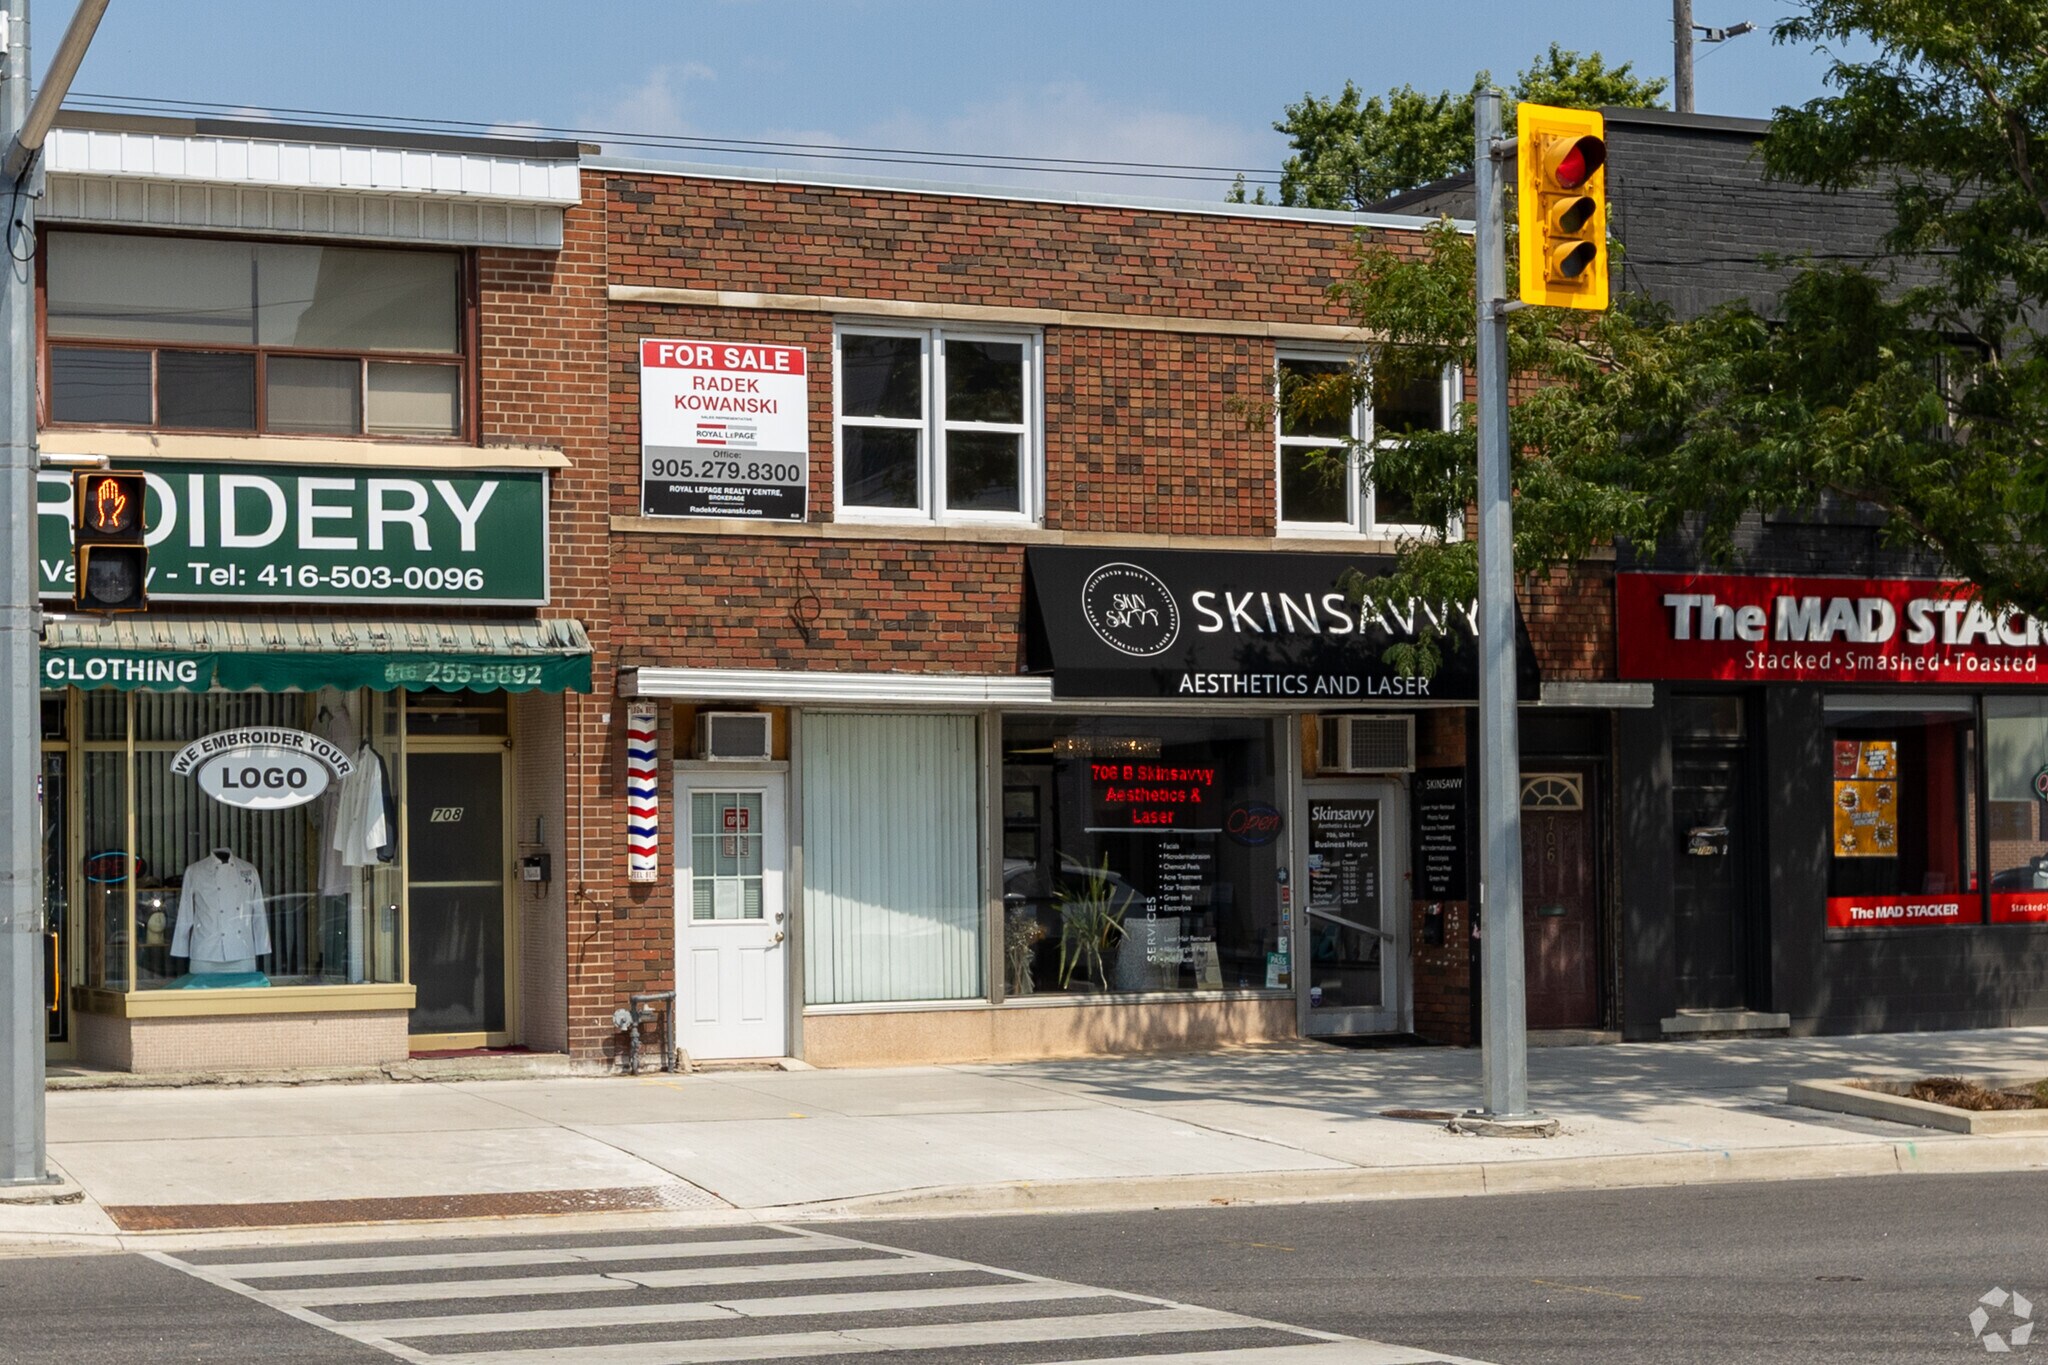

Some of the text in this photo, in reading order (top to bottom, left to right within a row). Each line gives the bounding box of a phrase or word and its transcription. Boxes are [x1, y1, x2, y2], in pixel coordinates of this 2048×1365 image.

[659, 344, 790, 371] FOR SALE
[693, 376, 760, 393] RADEK
[674, 395, 778, 414] KOWANSKI
[696, 430, 724, 438] ROYAL
[713, 450, 742, 459] Office:
[652, 459, 800, 482] 905.279.8300
[669, 485, 783, 497] ROYAL LEPAGE REALTY CENTRE,
[708, 494, 745, 502] BROKERAGE
[690, 506, 763, 515] RadekKowanski.com
[187, 562, 246, 586] Tel:
[257, 564, 484, 590] 416-503-0096
[1113, 593, 1146, 611] SKIN
[1664, 593, 1767, 641] The
[1776, 597, 1896, 643] MAD
[46, 658, 197, 682] CLOTHING
[1745, 650, 2037, 672] Stacked Smashed Toasted
[385, 661, 542, 685] 416 255-6892
[1179, 673, 1429, 695] AESTHETICS AND LASER
[175, 731, 350, 776] WE EMBROIDER YOUR
[222, 767, 307, 789] LOGO
[1137, 765, 1215, 786] Skinsavvy
[1426, 779, 1463, 790] SKINSAVVY
[1105, 787, 1201, 802] Aesthetics &
[432, 808, 462, 821] 708
[1132, 809, 1174, 824] Laser
[1227, 808, 1279, 833] Open
[1312, 806, 1375, 827] Skinsavvy
[1850, 903, 1959, 920] The MAD STACKER
[1147, 896, 1157, 962] SERVICES
[1270, 956, 1287, 965] PASS
